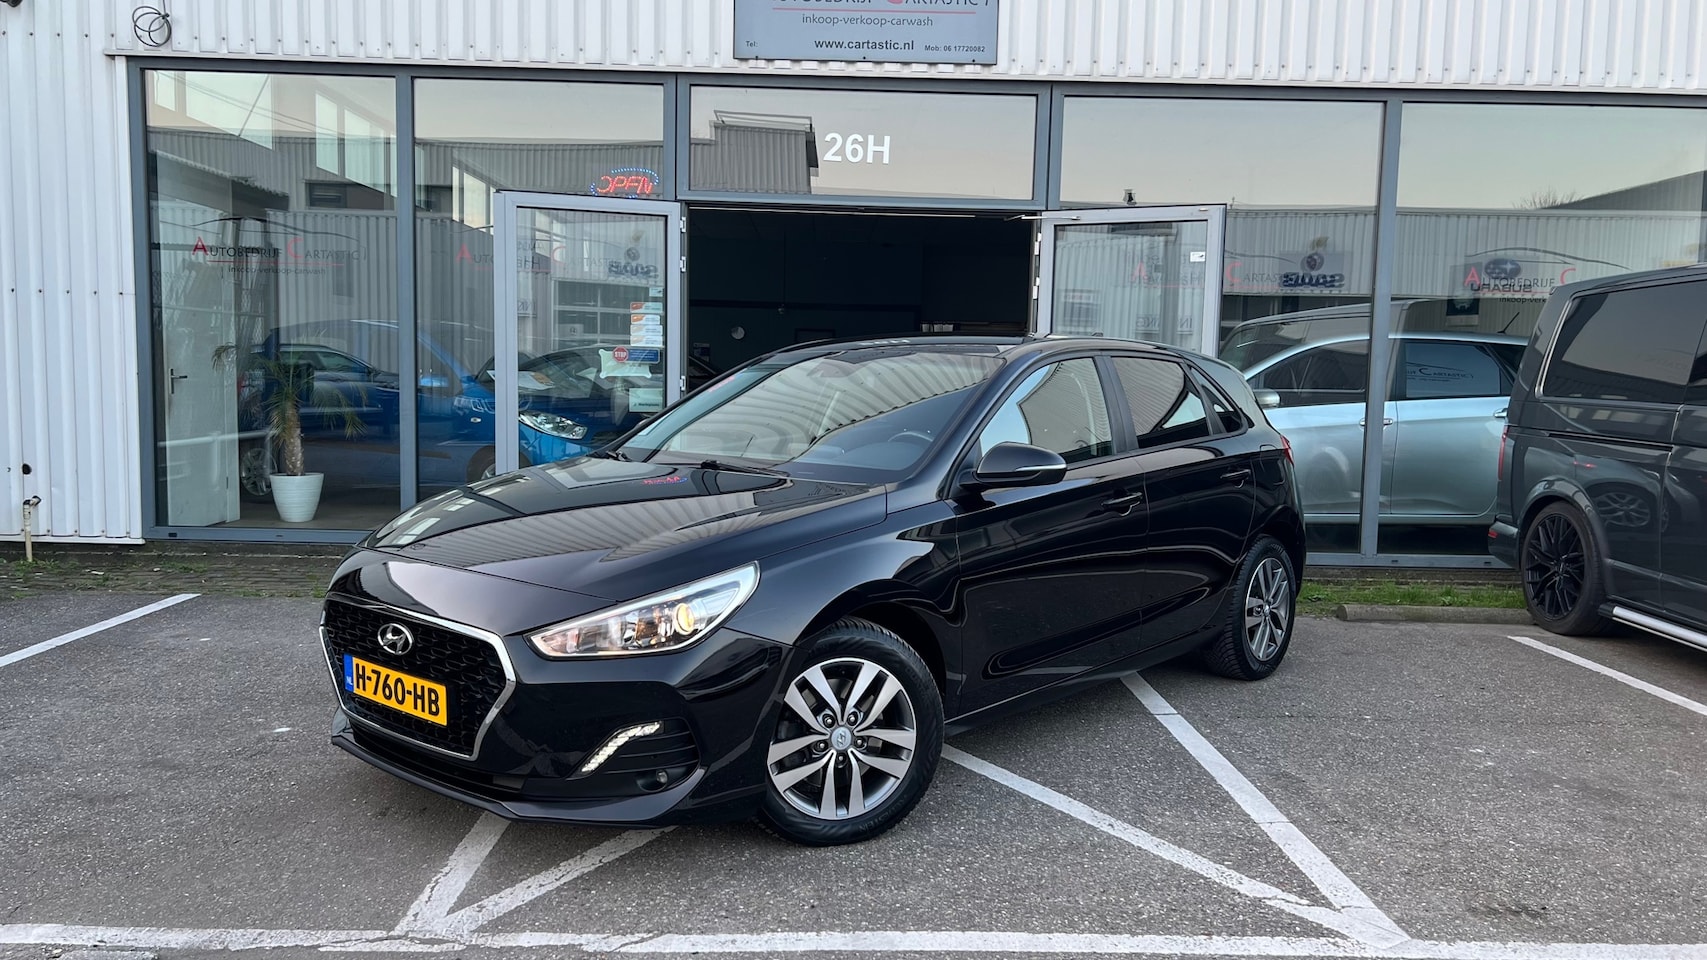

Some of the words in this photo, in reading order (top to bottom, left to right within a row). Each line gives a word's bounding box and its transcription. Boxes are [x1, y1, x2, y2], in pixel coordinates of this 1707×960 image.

[802, 13, 933, 27] inkoop-verkoop-carwash
[746, 40, 758, 48] Tel:
[814, 39, 914, 51] www.cartastic.nl
[924, 44, 942, 52] Mob:
[943, 44, 952, 52] 06
[823, 132, 890, 164] 26H
[355, 663, 440, 717] H-760-HB
